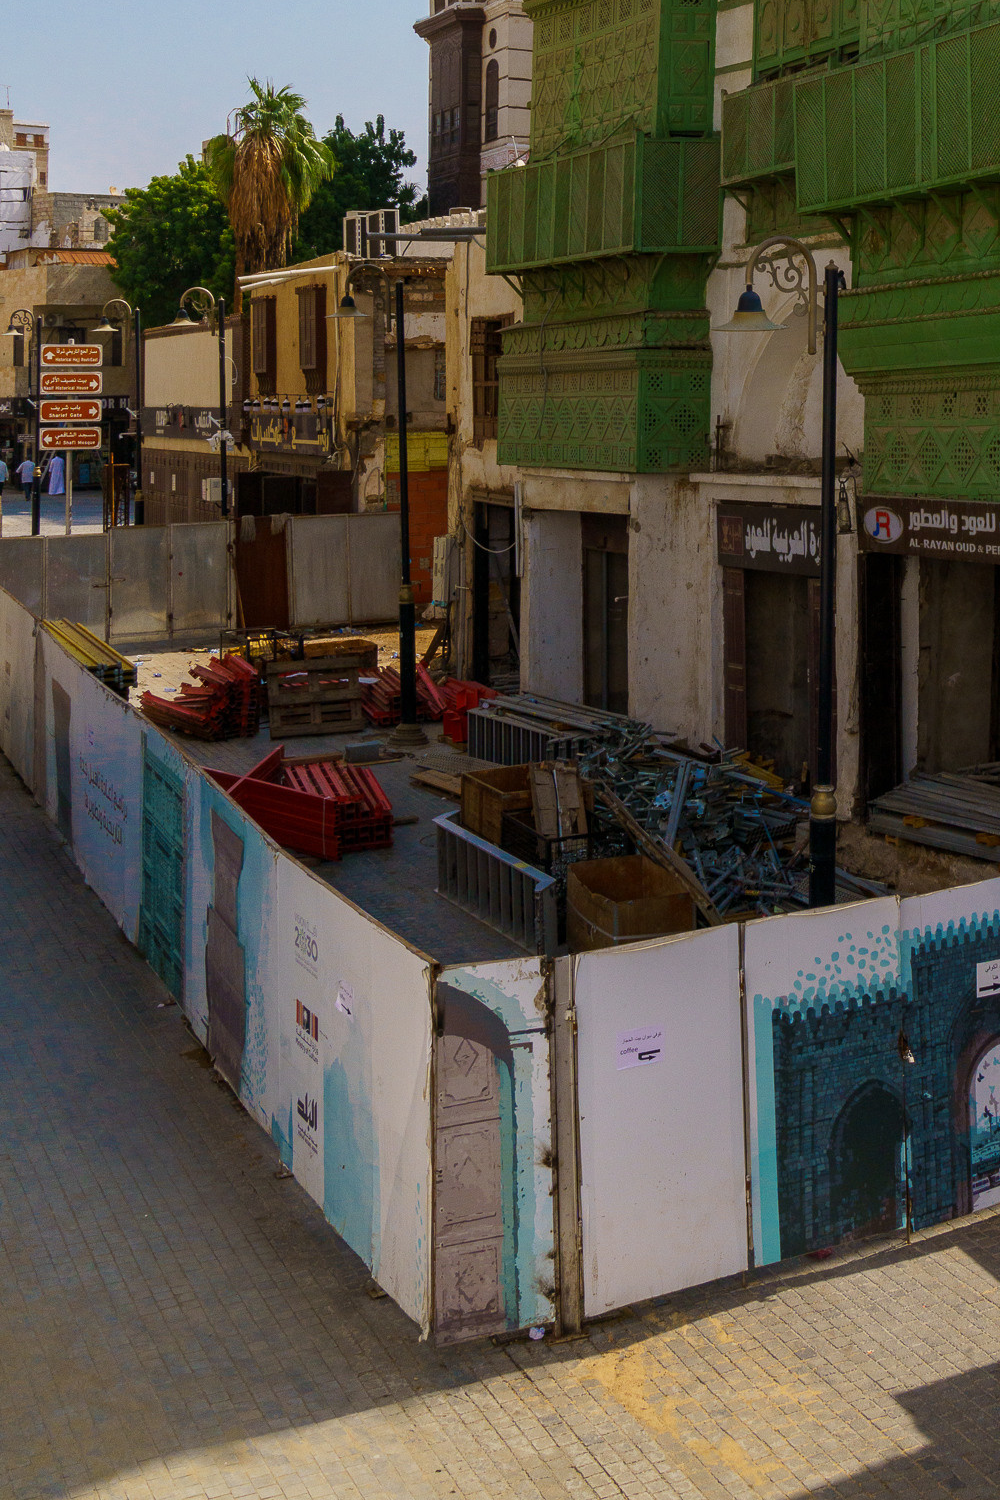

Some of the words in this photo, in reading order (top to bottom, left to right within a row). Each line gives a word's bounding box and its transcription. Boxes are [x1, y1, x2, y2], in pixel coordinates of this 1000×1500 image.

[50, 404, 69, 412] شريف
[908, 508, 958, 535] والعطور
[961, 512, 996, 536] للعود
[745, 517, 771, 559] للعود
[772, 518, 807, 563] العربية
[909, 538, 954, 551] AL-RAYAN
[956, 542, 976, 553] OUD
[977, 545, 984, 553] &
[619, 1046, 639, 1056] coffee
